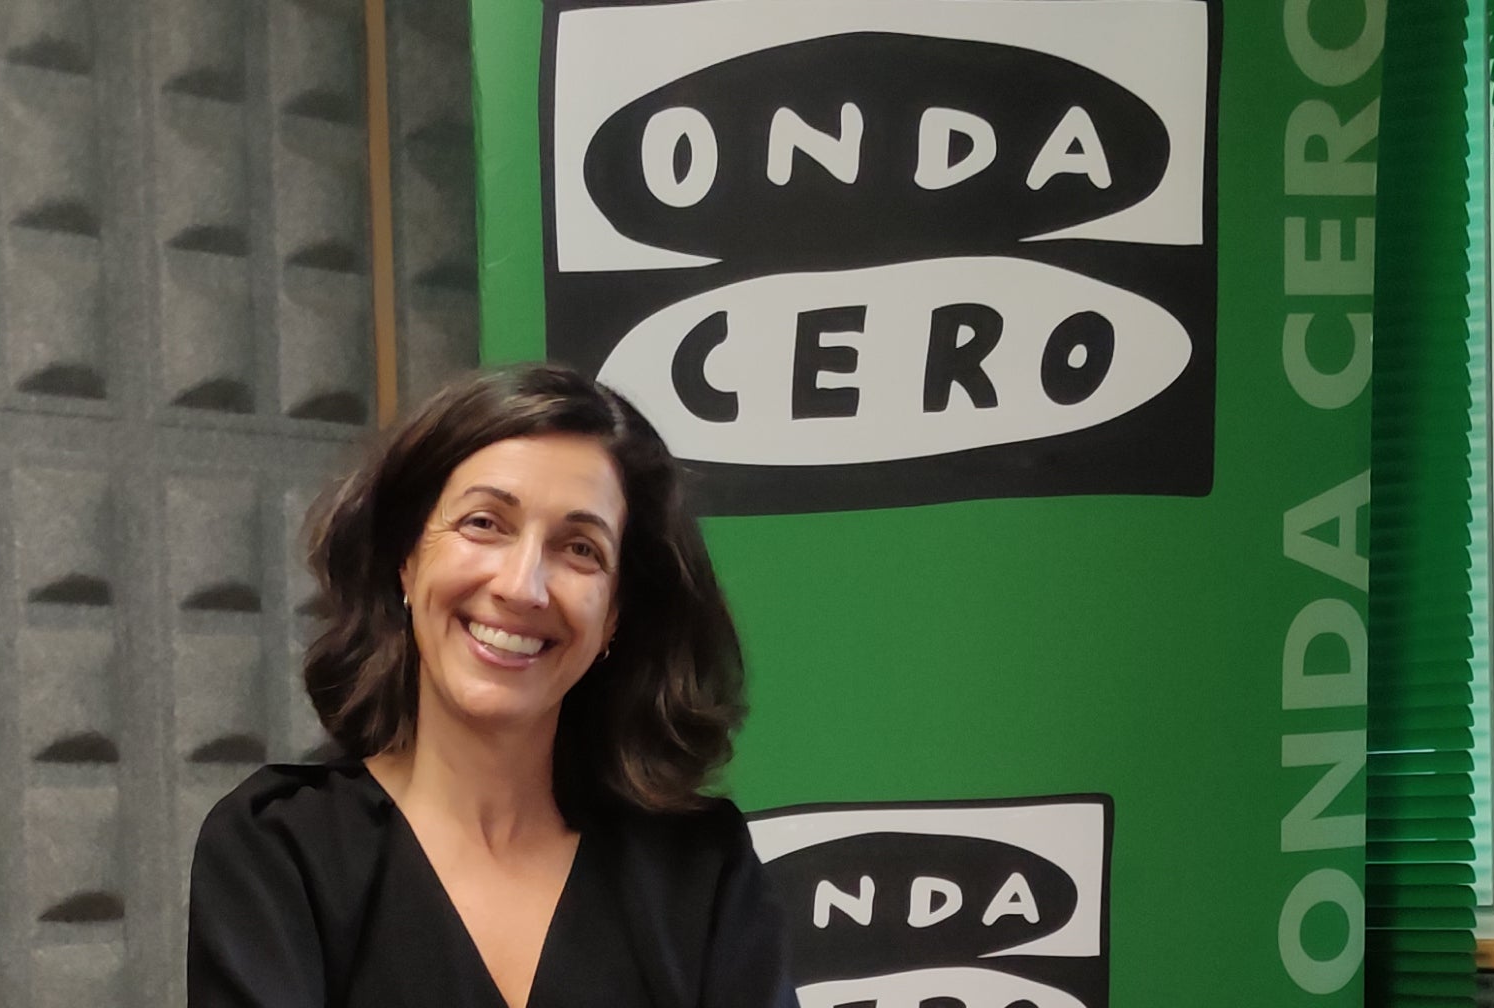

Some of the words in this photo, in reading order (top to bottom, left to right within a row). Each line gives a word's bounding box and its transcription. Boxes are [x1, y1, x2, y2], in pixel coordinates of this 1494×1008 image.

[642, 103, 1112, 207] ONDA
[671, 303, 1115, 423] CERO
[1278, 469, 1371, 995] ONDA
[813, 872, 1040, 928] NDA
